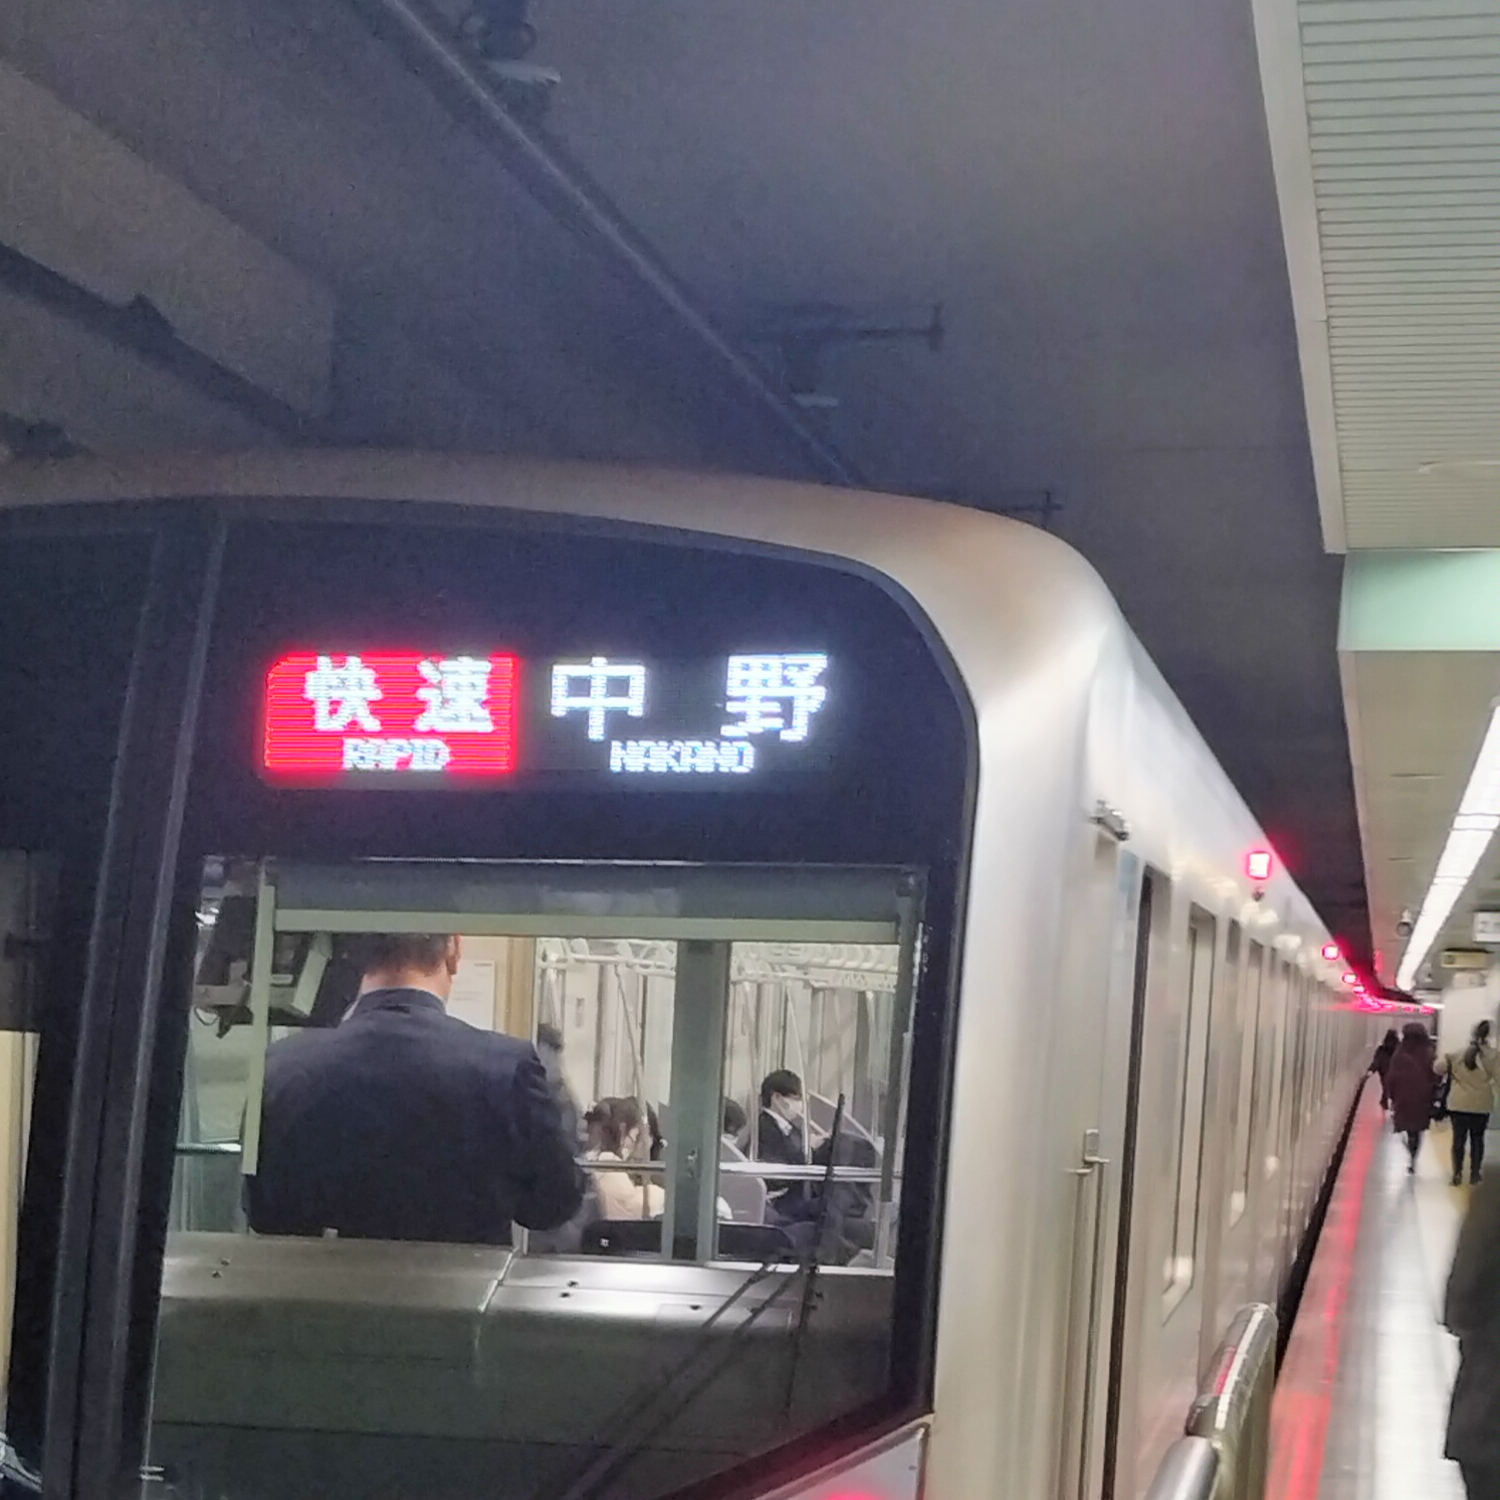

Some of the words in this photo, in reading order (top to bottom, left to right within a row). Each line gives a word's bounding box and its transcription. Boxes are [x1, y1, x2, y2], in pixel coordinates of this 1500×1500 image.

[302, 655, 494, 733] 快速
[550, 653, 828, 740] 中野
[610, 740, 754, 773] NAKANO
